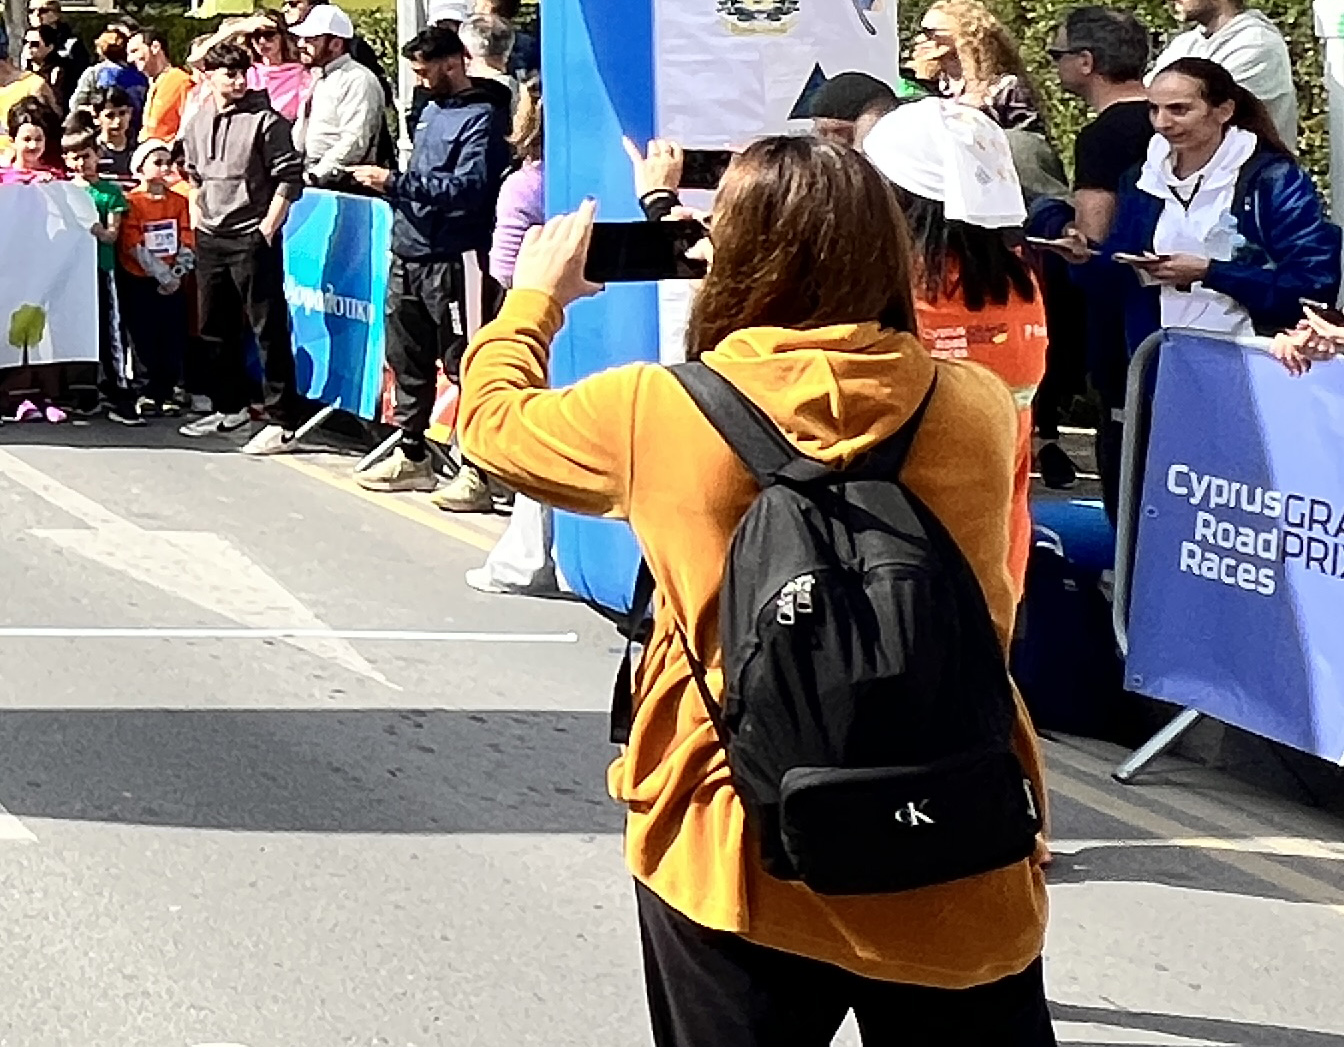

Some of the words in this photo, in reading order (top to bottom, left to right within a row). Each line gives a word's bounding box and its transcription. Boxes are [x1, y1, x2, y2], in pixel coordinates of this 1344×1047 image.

[1167, 464, 1282, 518] Cyprus
[1180, 540, 1276, 596] Races
[1194, 510, 1278, 562] Road
[1282, 530, 1344, 580] PRI
